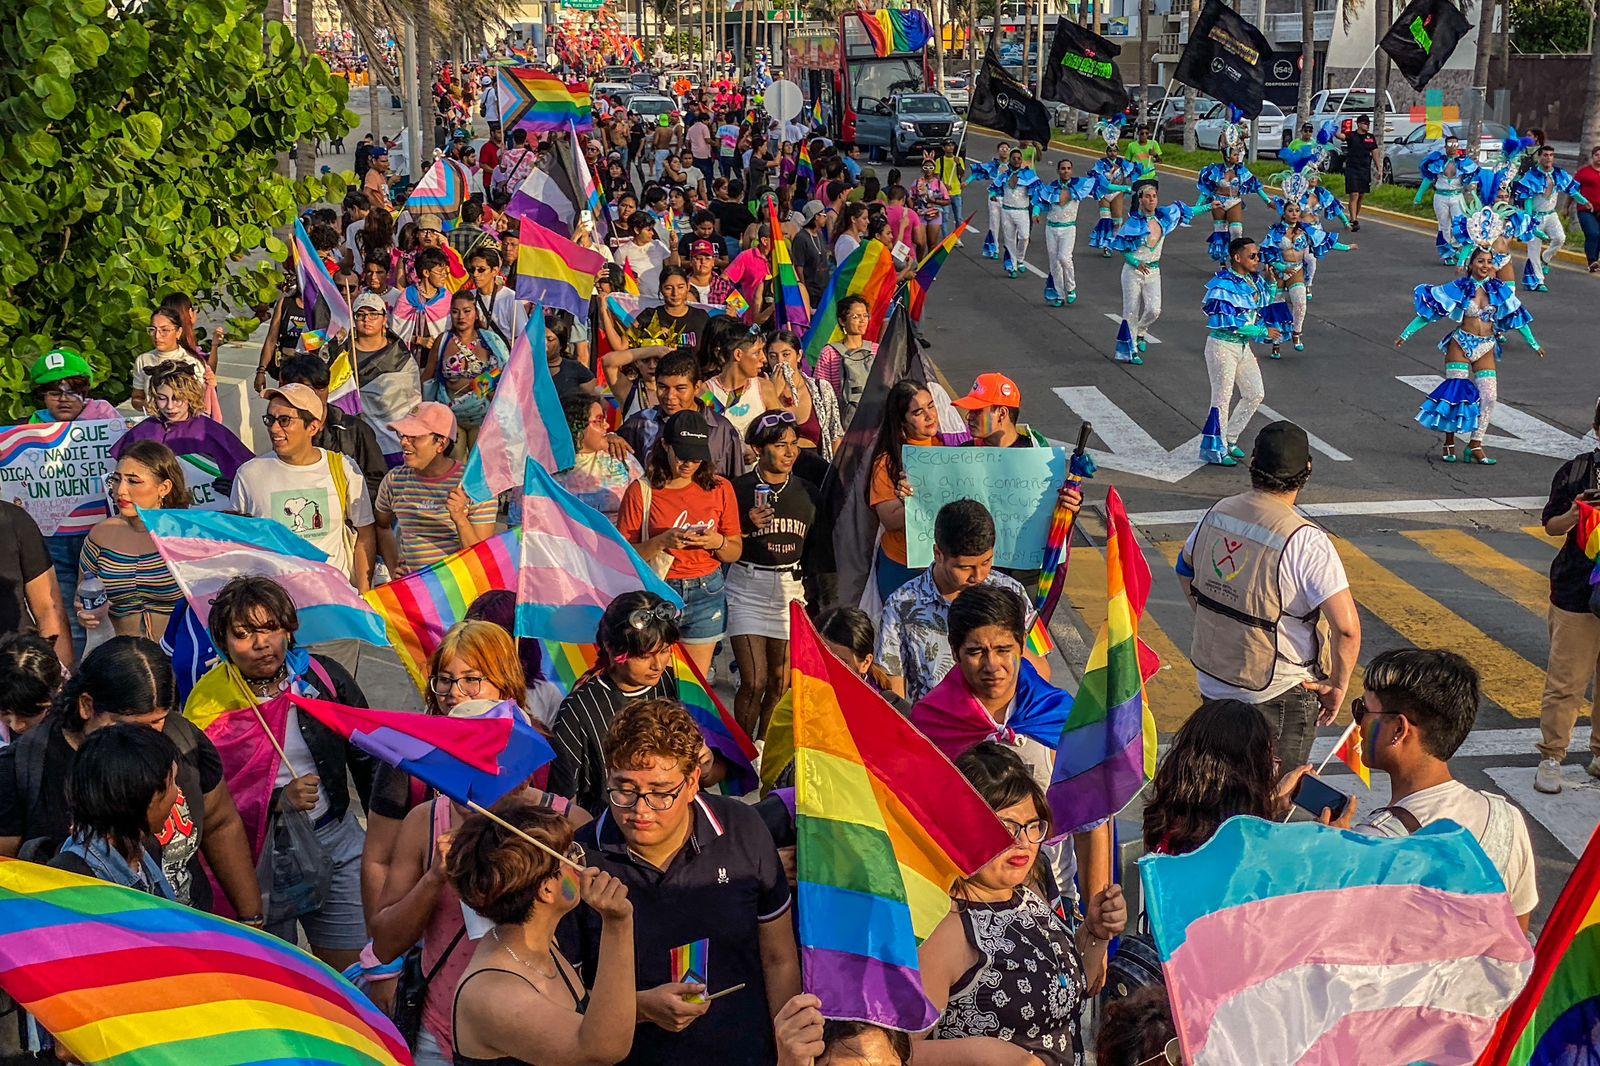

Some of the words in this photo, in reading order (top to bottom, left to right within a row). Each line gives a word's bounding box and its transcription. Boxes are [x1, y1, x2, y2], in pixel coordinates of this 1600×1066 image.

[69, 424, 109, 442] QUE
[44, 446, 89, 462] NADIE
[92, 443, 112, 459] TE
[0, 467, 34, 482] DIGA
[39, 463, 76, 480] COMO
[80, 461, 108, 477] SER
[55, 478, 90, 497] BUEN
[192, 482, 216, 504] CE
